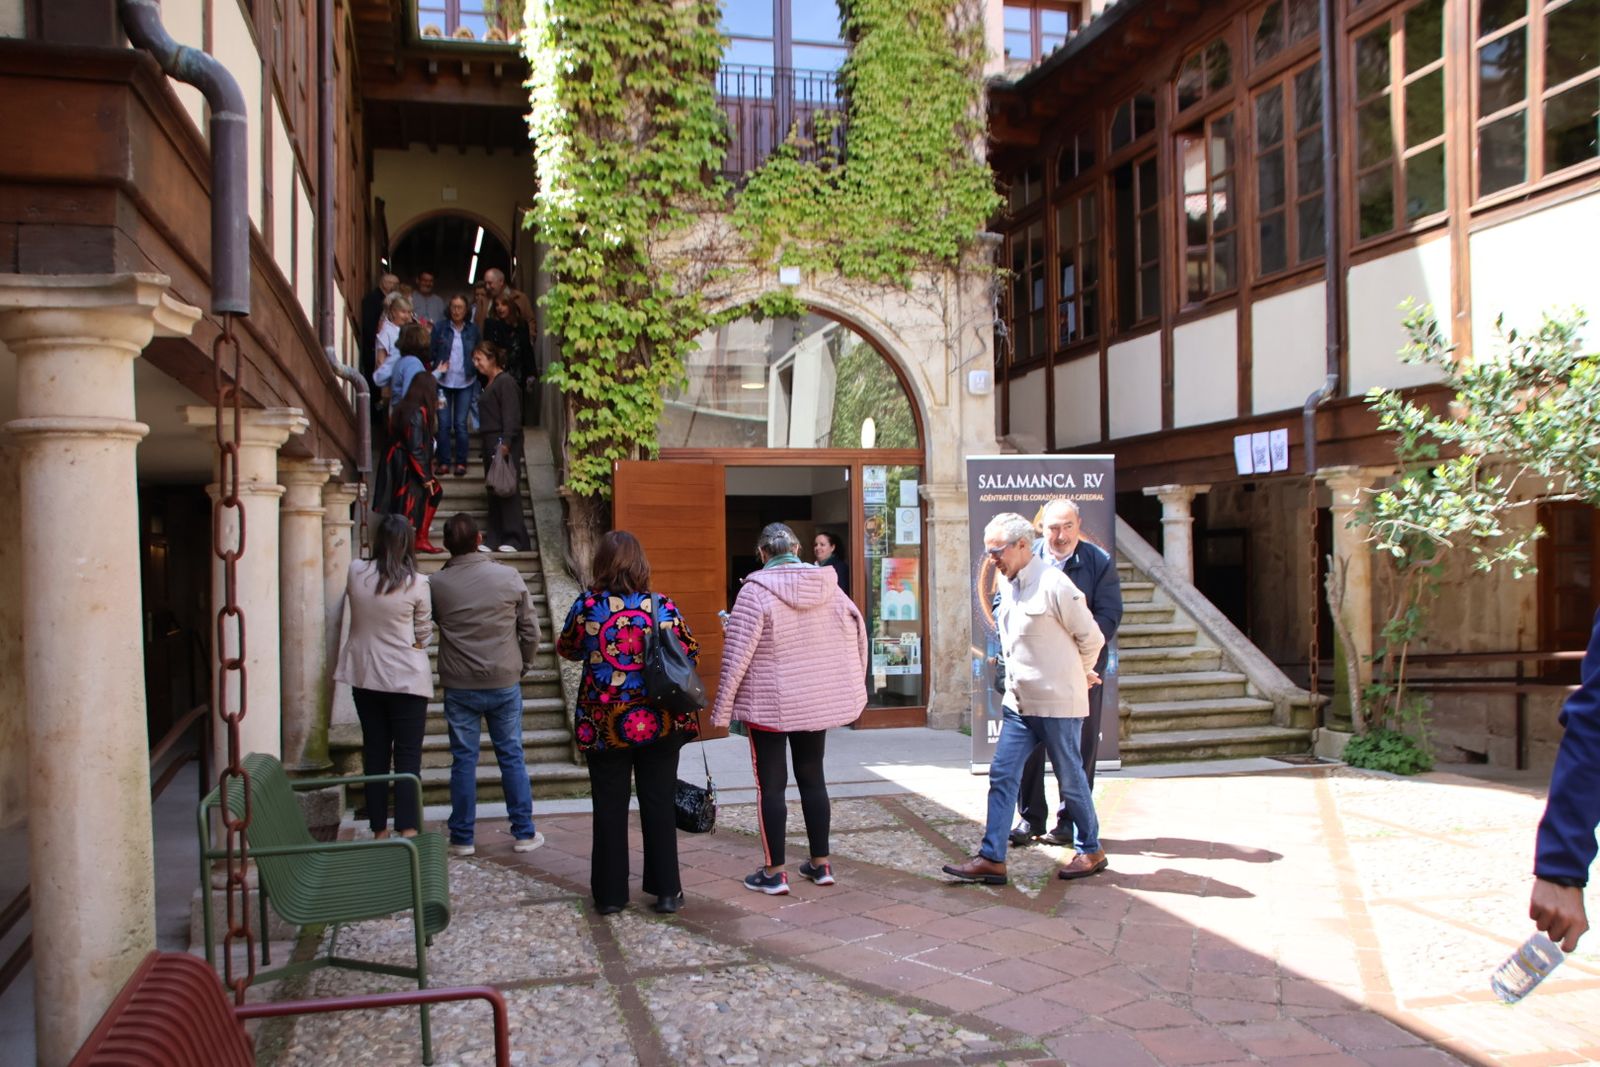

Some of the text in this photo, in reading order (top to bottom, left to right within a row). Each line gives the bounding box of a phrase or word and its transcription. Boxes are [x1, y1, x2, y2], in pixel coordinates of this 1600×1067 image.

[978, 473, 1104, 488] SALAMANCA RV
[979, 493, 1013, 502] ADÉNTRATE
[1013, 494, 1022, 502] EN
[1022, 494, 1029, 502] EL
[1075, 494, 1105, 502] CATEDRAL
